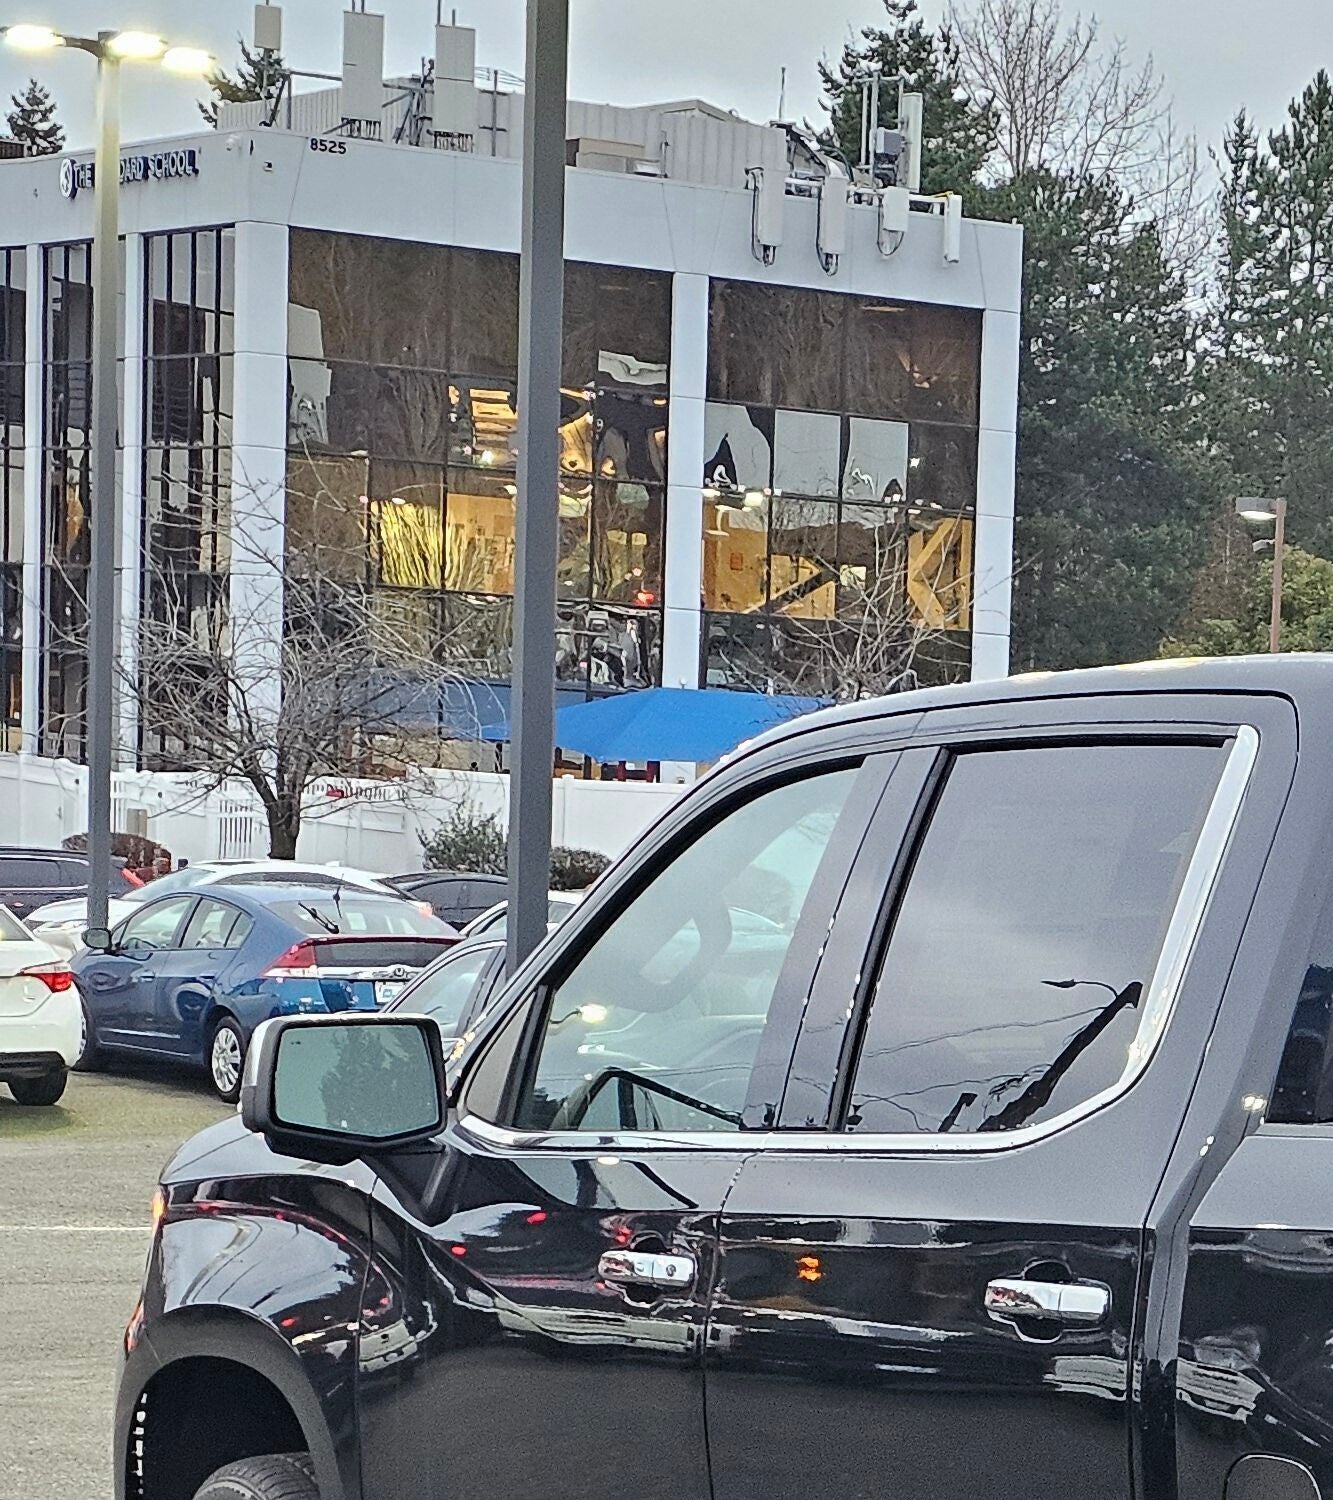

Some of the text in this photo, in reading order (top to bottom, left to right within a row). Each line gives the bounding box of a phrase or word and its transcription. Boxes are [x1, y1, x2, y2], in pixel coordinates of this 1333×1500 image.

[310, 138, 346, 154] 8525
[74, 163, 95, 188] THE
[149, 150, 199, 179] SCHOOL
